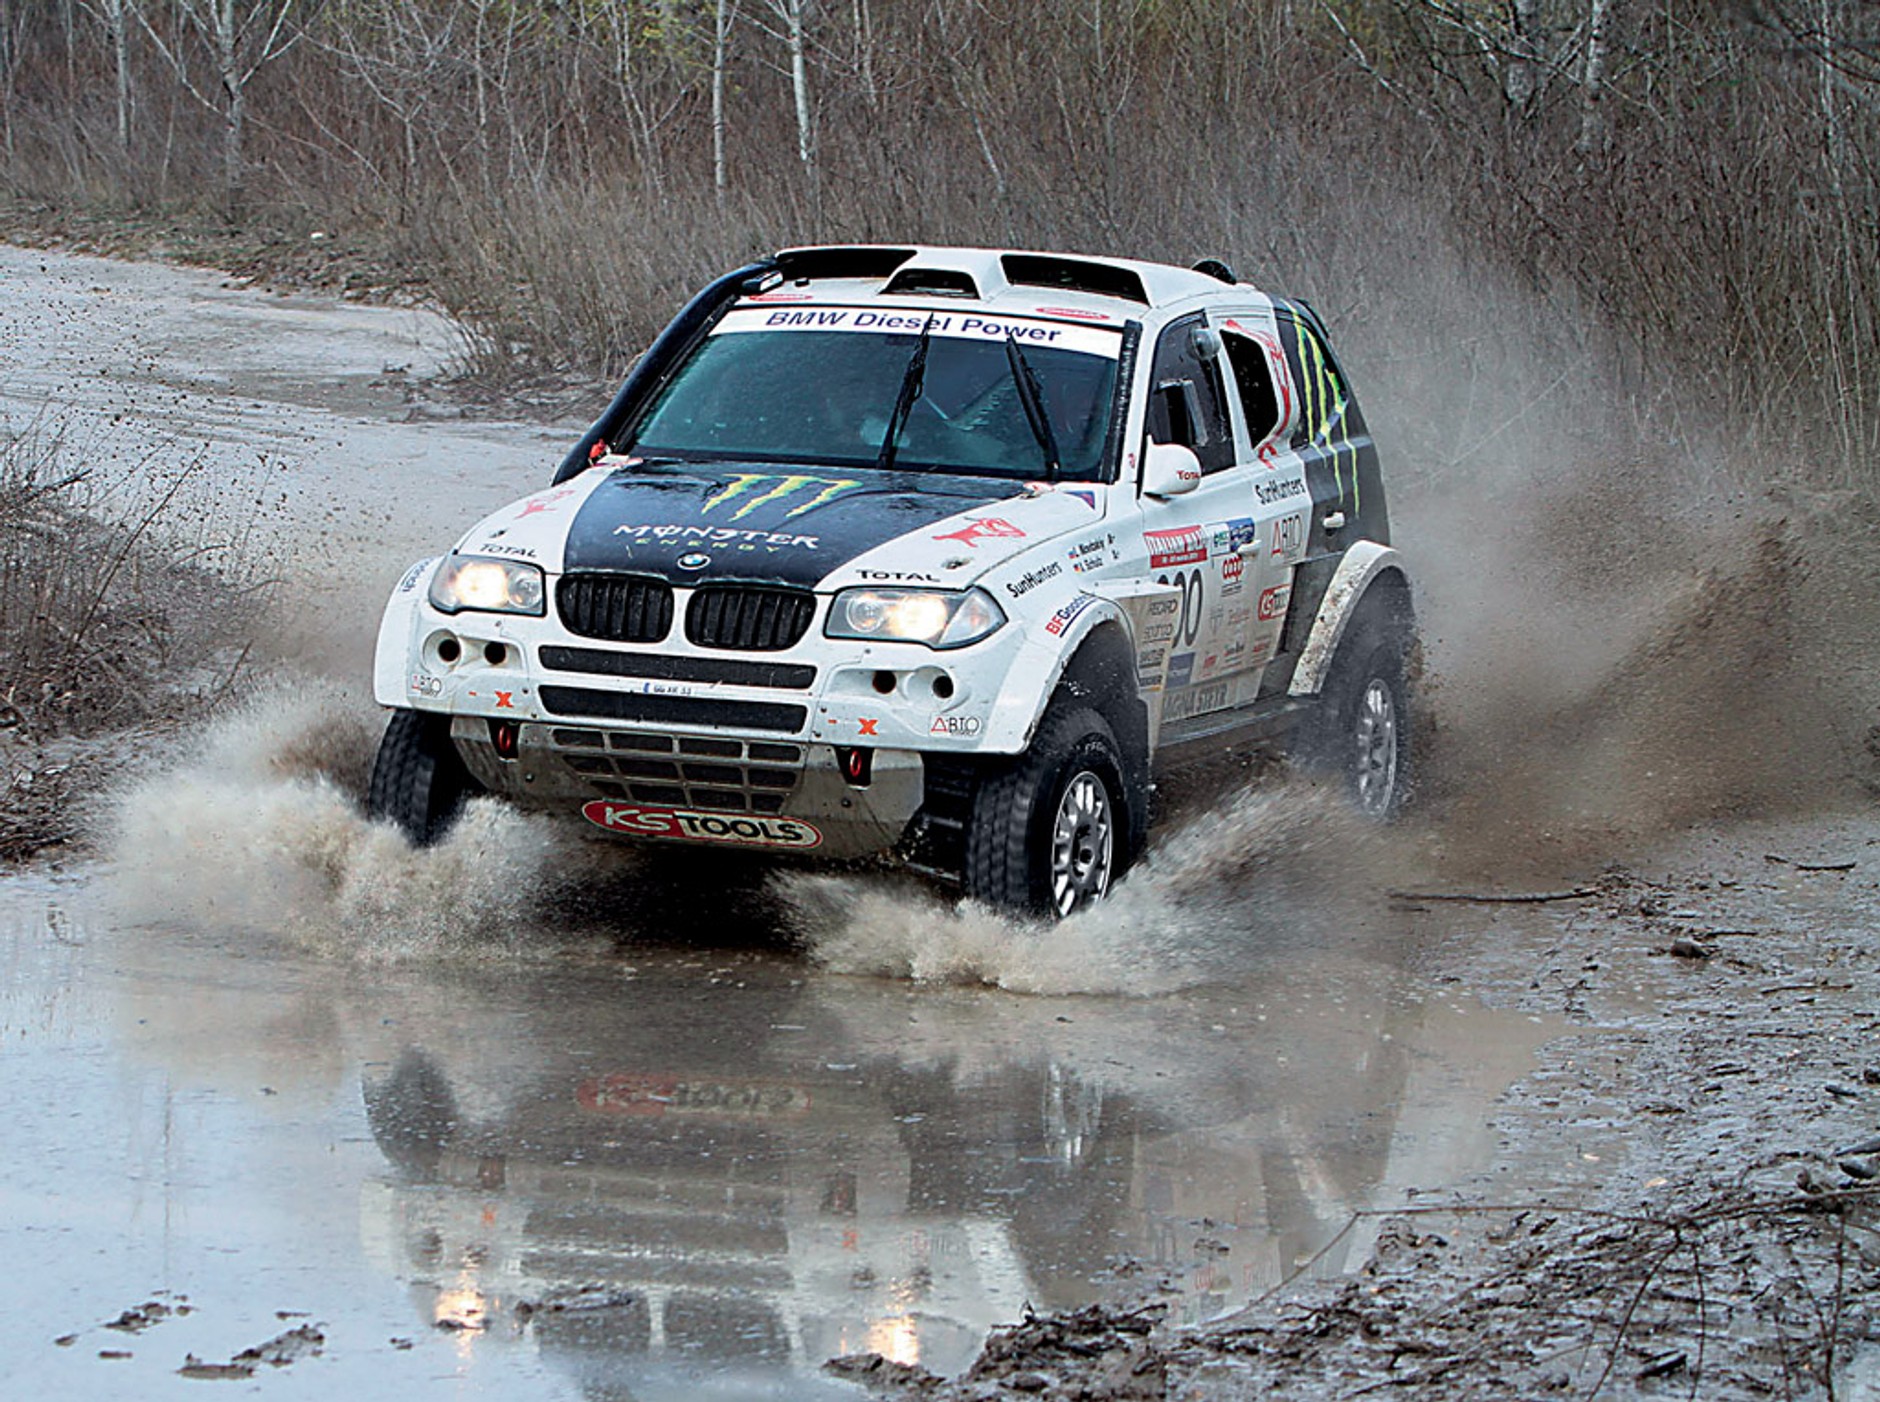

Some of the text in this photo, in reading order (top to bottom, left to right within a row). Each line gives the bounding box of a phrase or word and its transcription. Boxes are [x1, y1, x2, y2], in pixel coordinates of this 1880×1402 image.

[765, 312, 1062, 343] BMW Diesel Power
[479, 543, 538, 558] TOTAL
[634, 537, 780, 553] ENERGY
[855, 568, 943, 583] TOTAL
[1006, 561, 1064, 598] SunHunters
[603, 805, 805, 842] KS TOOLS
